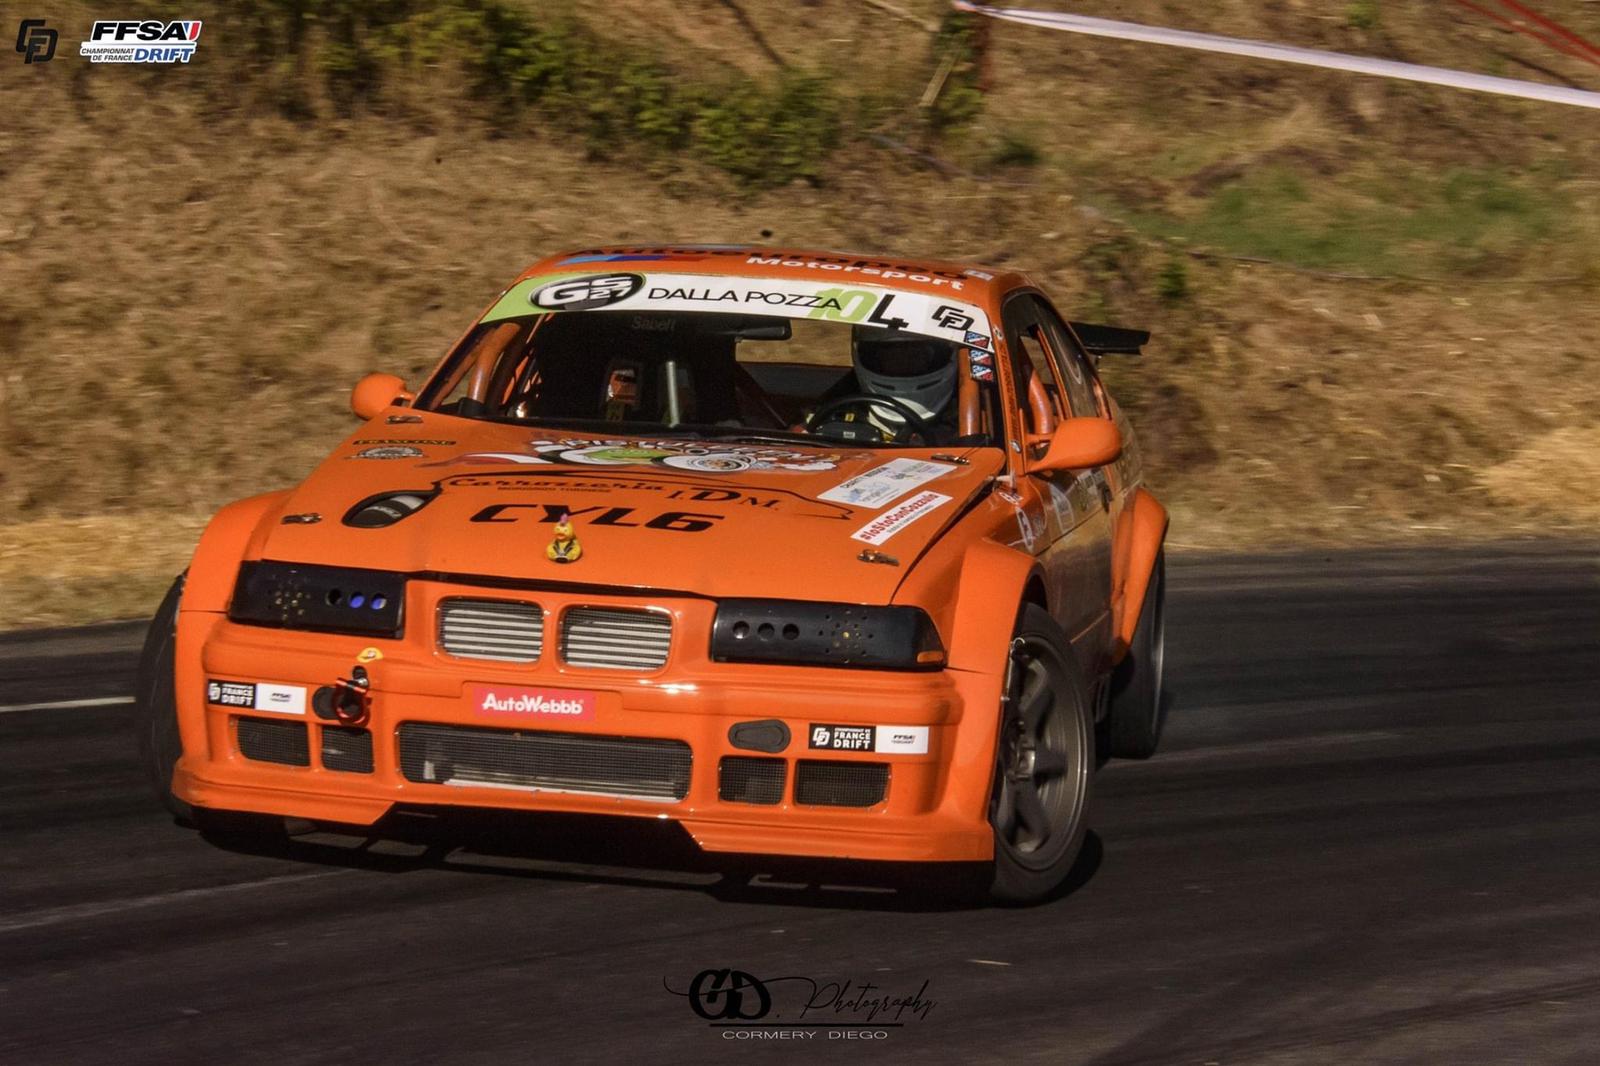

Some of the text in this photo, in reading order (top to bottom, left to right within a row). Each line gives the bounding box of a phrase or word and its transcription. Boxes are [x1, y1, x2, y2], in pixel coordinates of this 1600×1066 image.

[746, 256, 965, 291] Motorsport
[647, 288, 738, 303] DALLA
[744, 290, 842, 311] POZZA
[470, 503, 726, 533] CYL6
[221, 694, 253, 706] DRIFT
[482, 692, 583, 715] AutoWebbb
[833, 739, 871, 749] DRIFT
